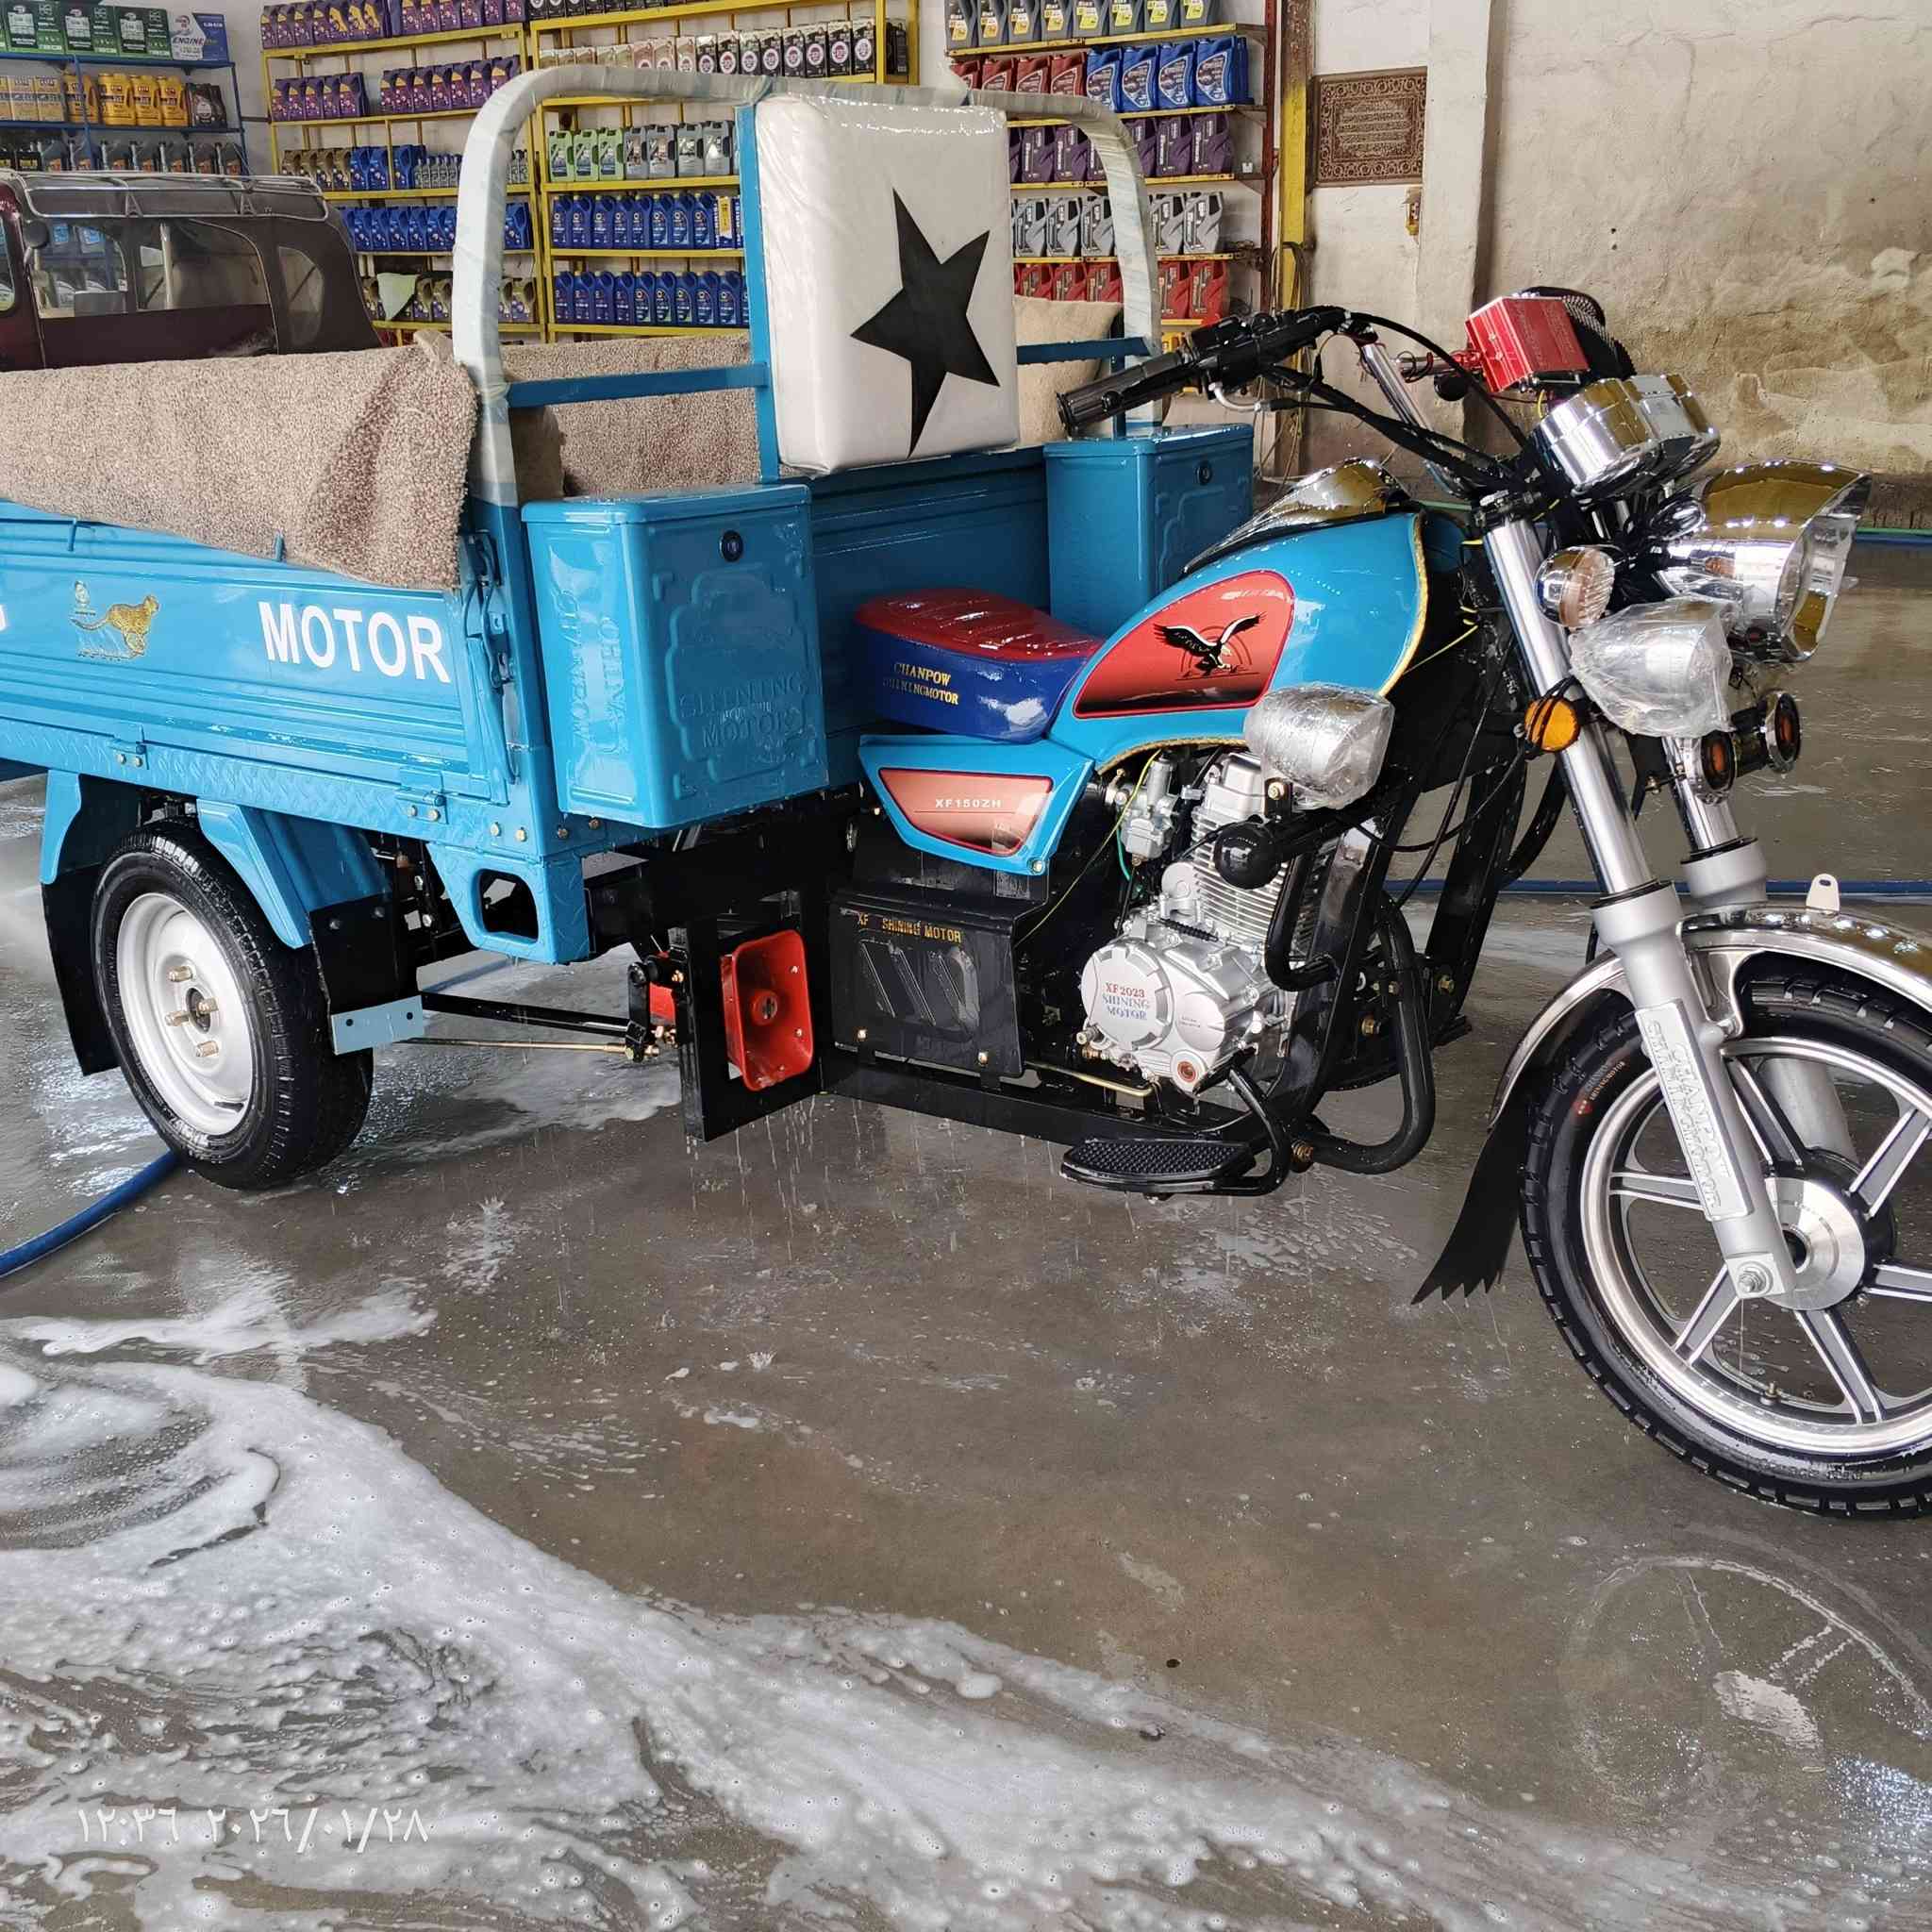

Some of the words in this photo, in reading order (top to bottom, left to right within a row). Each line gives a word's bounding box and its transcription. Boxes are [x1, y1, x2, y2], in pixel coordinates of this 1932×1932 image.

[258, 601, 450, 683] MOTOR
[893, 662, 951, 687] CHANPOW
[936, 798, 1003, 808] XF150ZH
[858, 913, 869, 926] XF
[881, 917, 921, 936] SHINING
[924, 924, 961, 943] MOTOR
[1102, 993, 1150, 1009] SHINING
[1107, 1006, 1148, 1020] MOTOR
